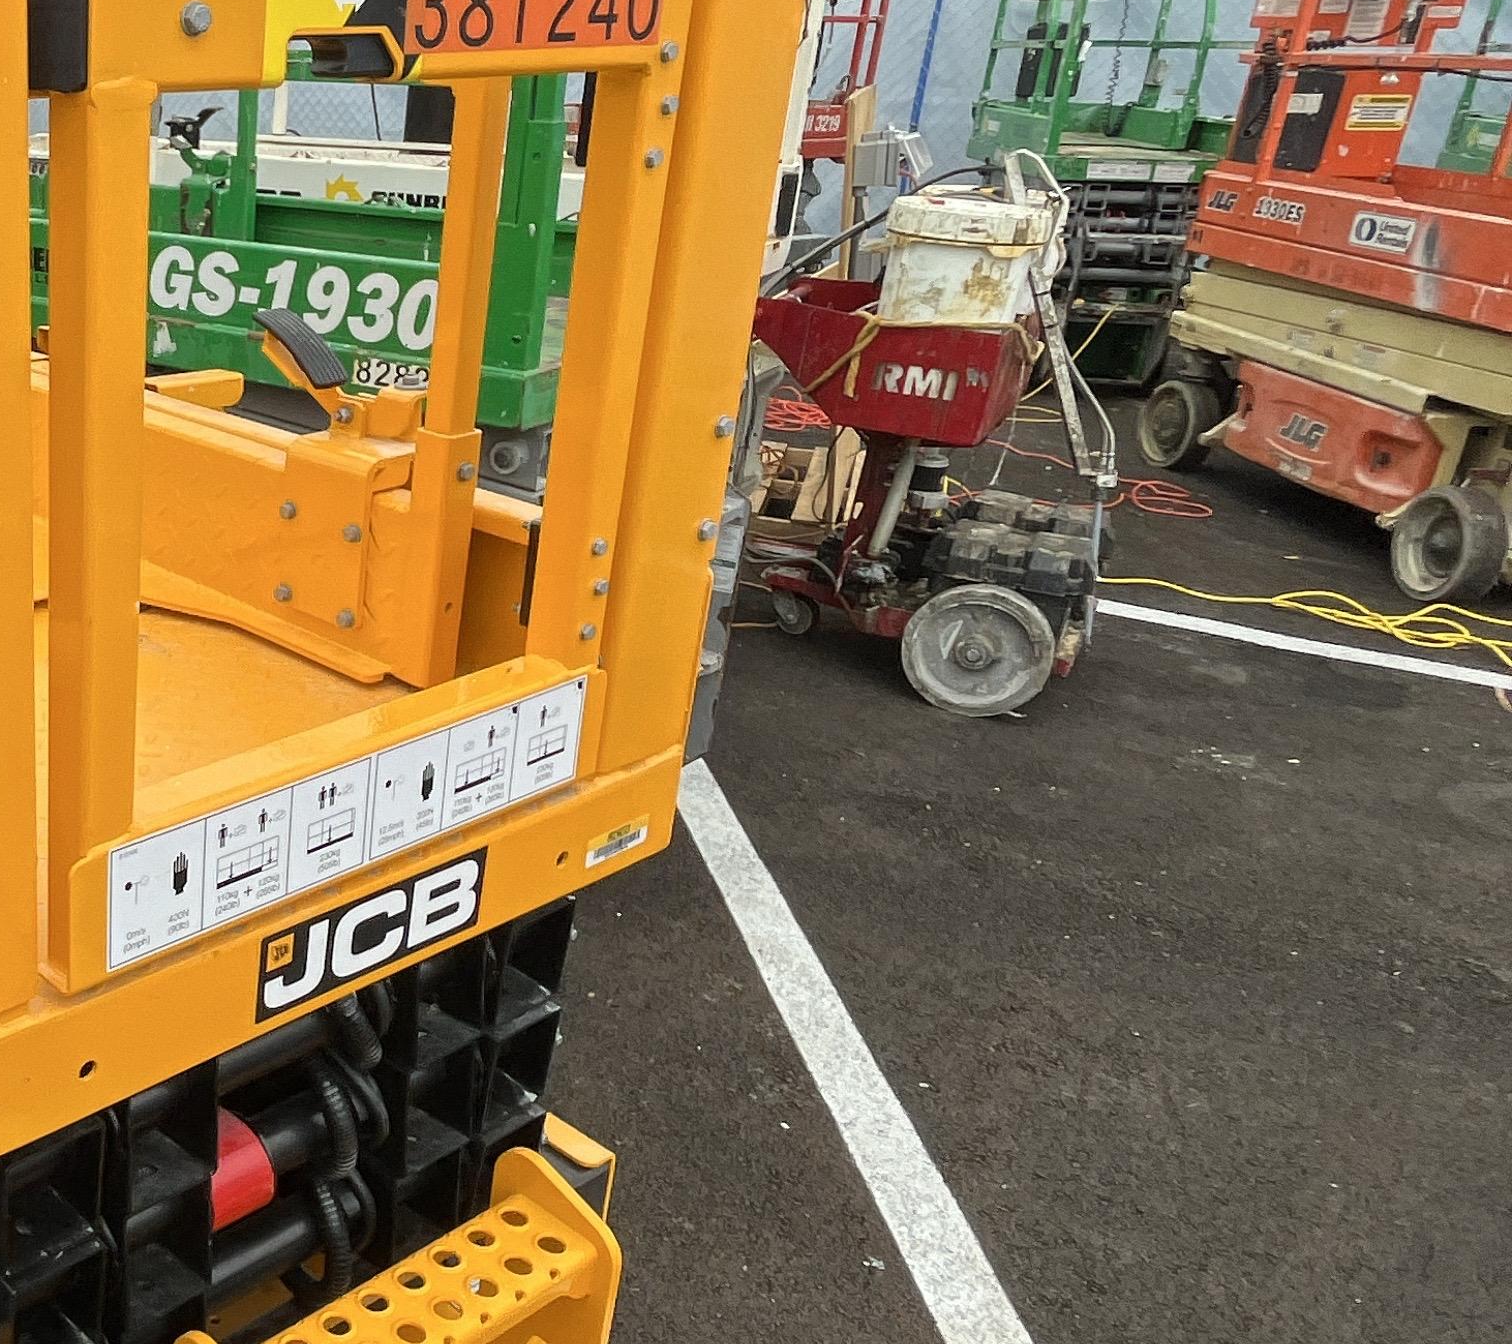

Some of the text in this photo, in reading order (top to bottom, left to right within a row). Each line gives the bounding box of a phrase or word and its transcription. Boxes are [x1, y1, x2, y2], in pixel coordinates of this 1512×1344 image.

[148, 244, 439, 351] GS-1930
[1279, 413, 1328, 449] JLG
[263, 859, 480, 1009] JCB
